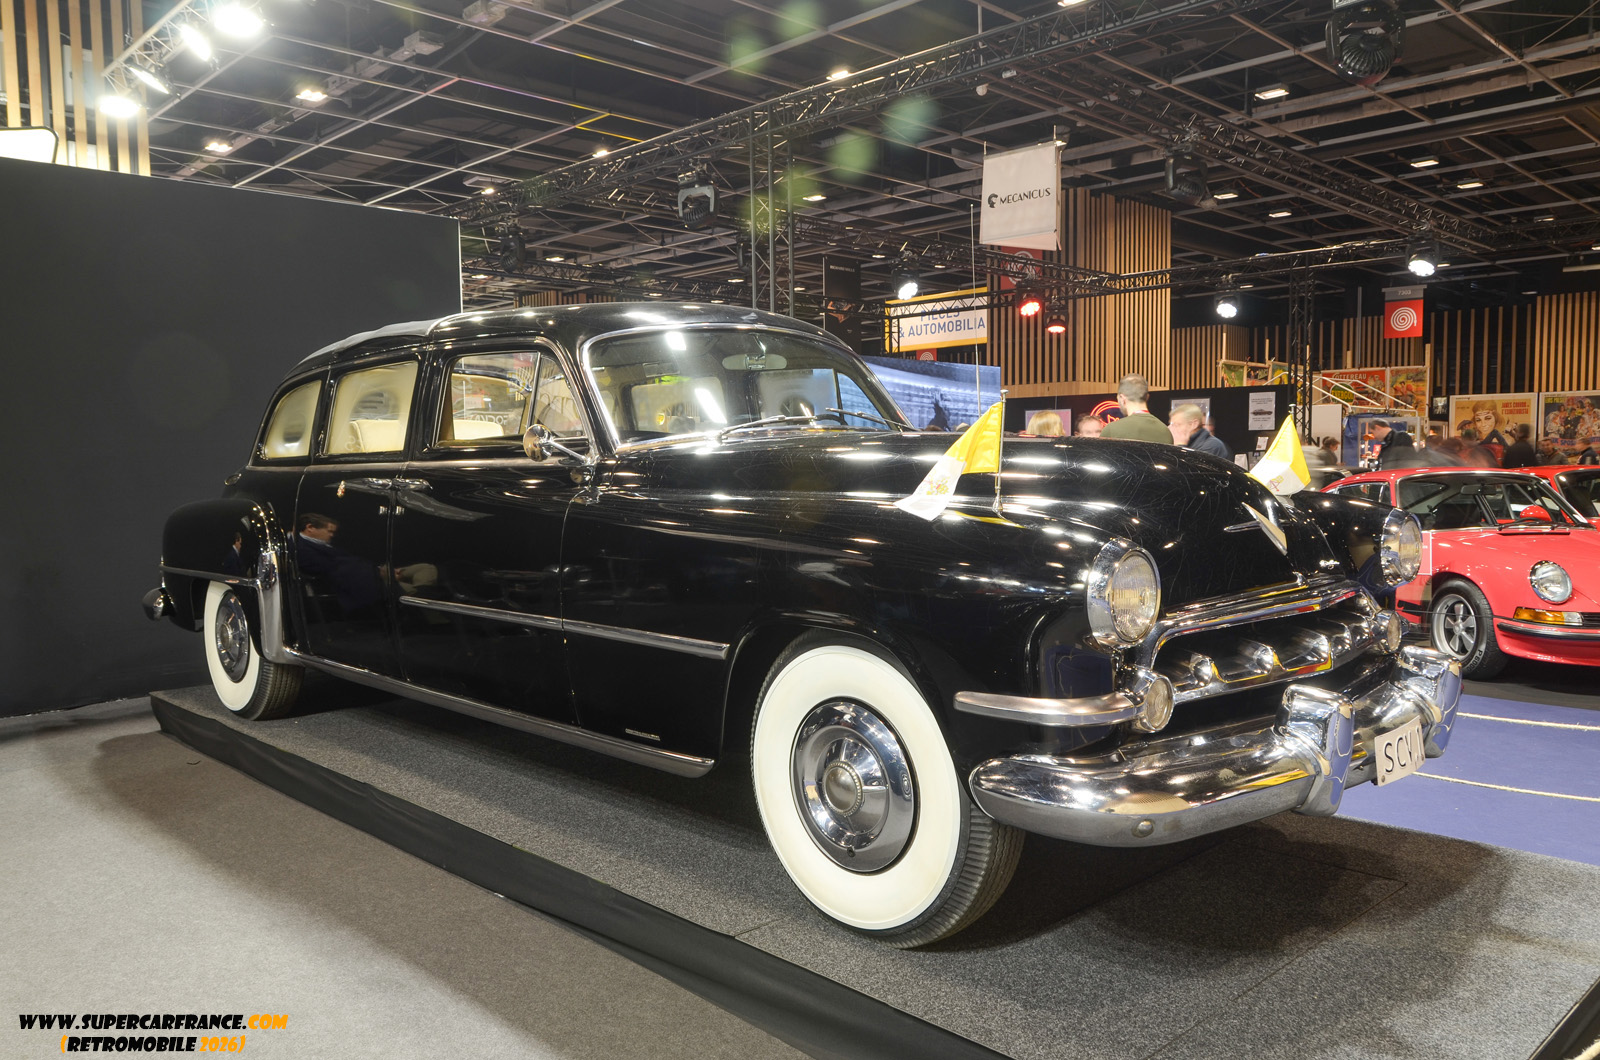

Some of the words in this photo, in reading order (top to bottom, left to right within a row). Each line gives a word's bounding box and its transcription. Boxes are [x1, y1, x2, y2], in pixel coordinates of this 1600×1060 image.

[1000, 188, 1051, 204] MECANICUS
[908, 316, 986, 338] AUTOMOBILIA
[1384, 731, 1412, 773] SCV
